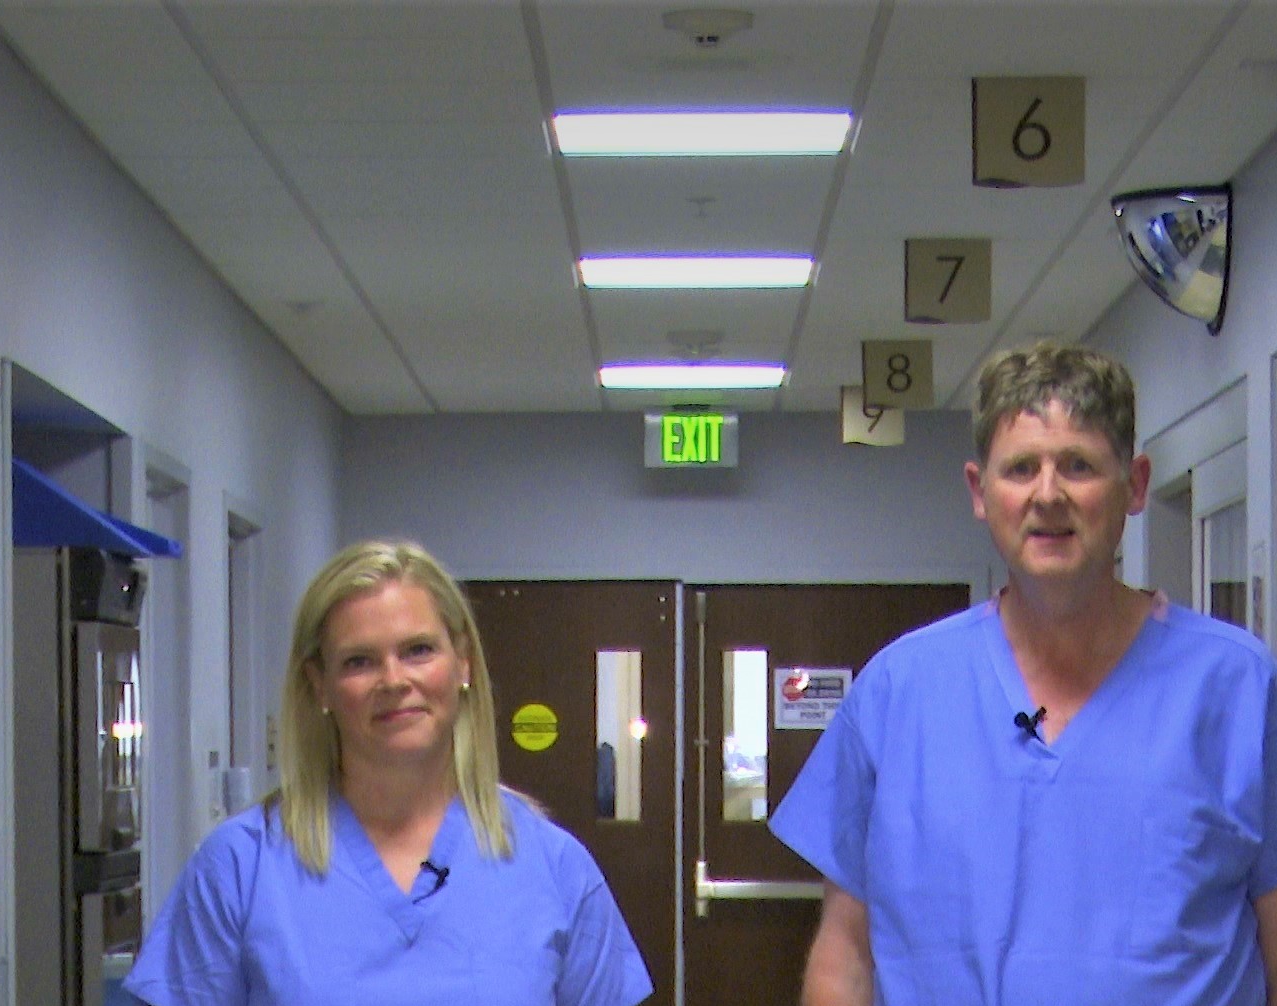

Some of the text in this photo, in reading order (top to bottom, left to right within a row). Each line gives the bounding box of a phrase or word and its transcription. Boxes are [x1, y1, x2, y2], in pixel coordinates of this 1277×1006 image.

[1012, 97, 1052, 162] 6
[935, 255, 966, 303] 7
[886, 353, 913, 393] 8
[663, 416, 724, 462] EXIT
